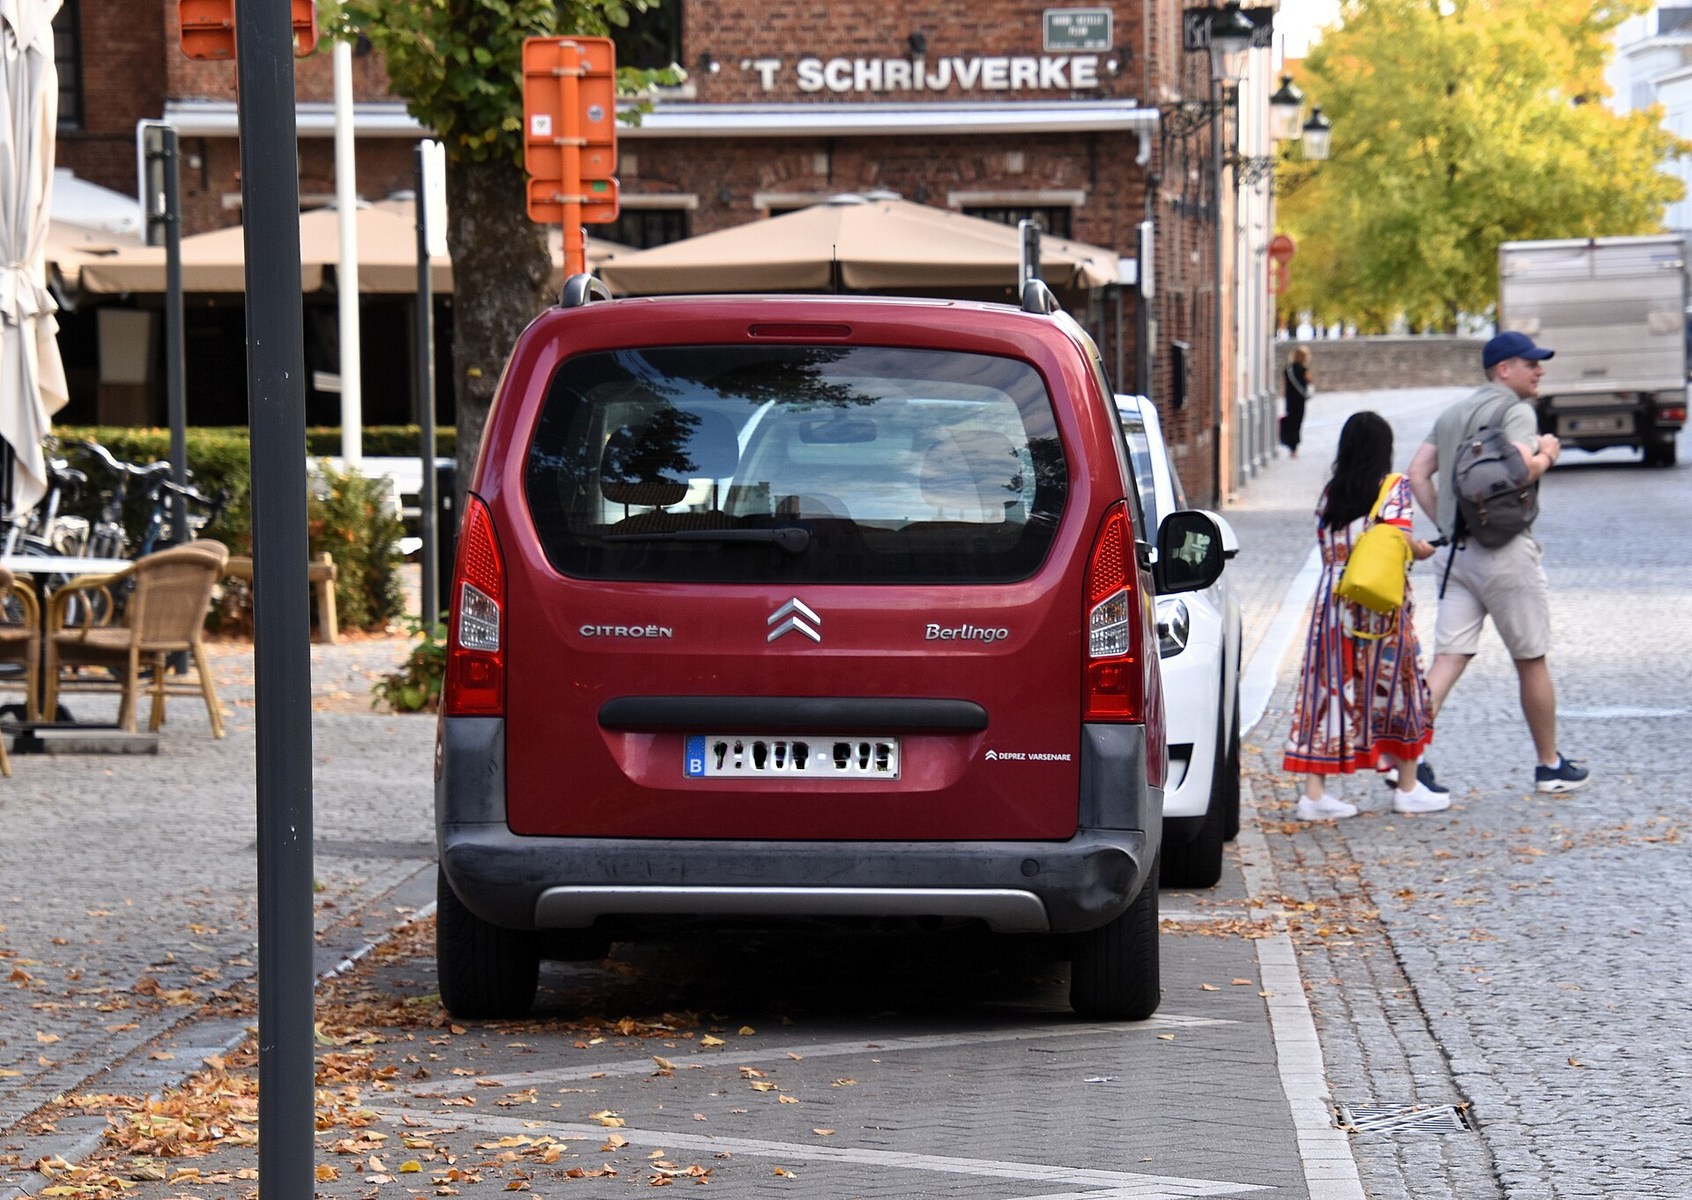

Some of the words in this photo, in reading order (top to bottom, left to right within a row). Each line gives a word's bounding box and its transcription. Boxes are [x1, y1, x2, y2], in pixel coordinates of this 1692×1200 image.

[797, 55, 1099, 92] SCHRIJVERKE
[579, 624, 673, 638] CITROËN
[925, 623, 1009, 643] Berlingo
[998, 752, 1026, 761] DEPREZ
[1028, 753, 1071, 761] VARSENARE
[689, 758, 702, 773] B
